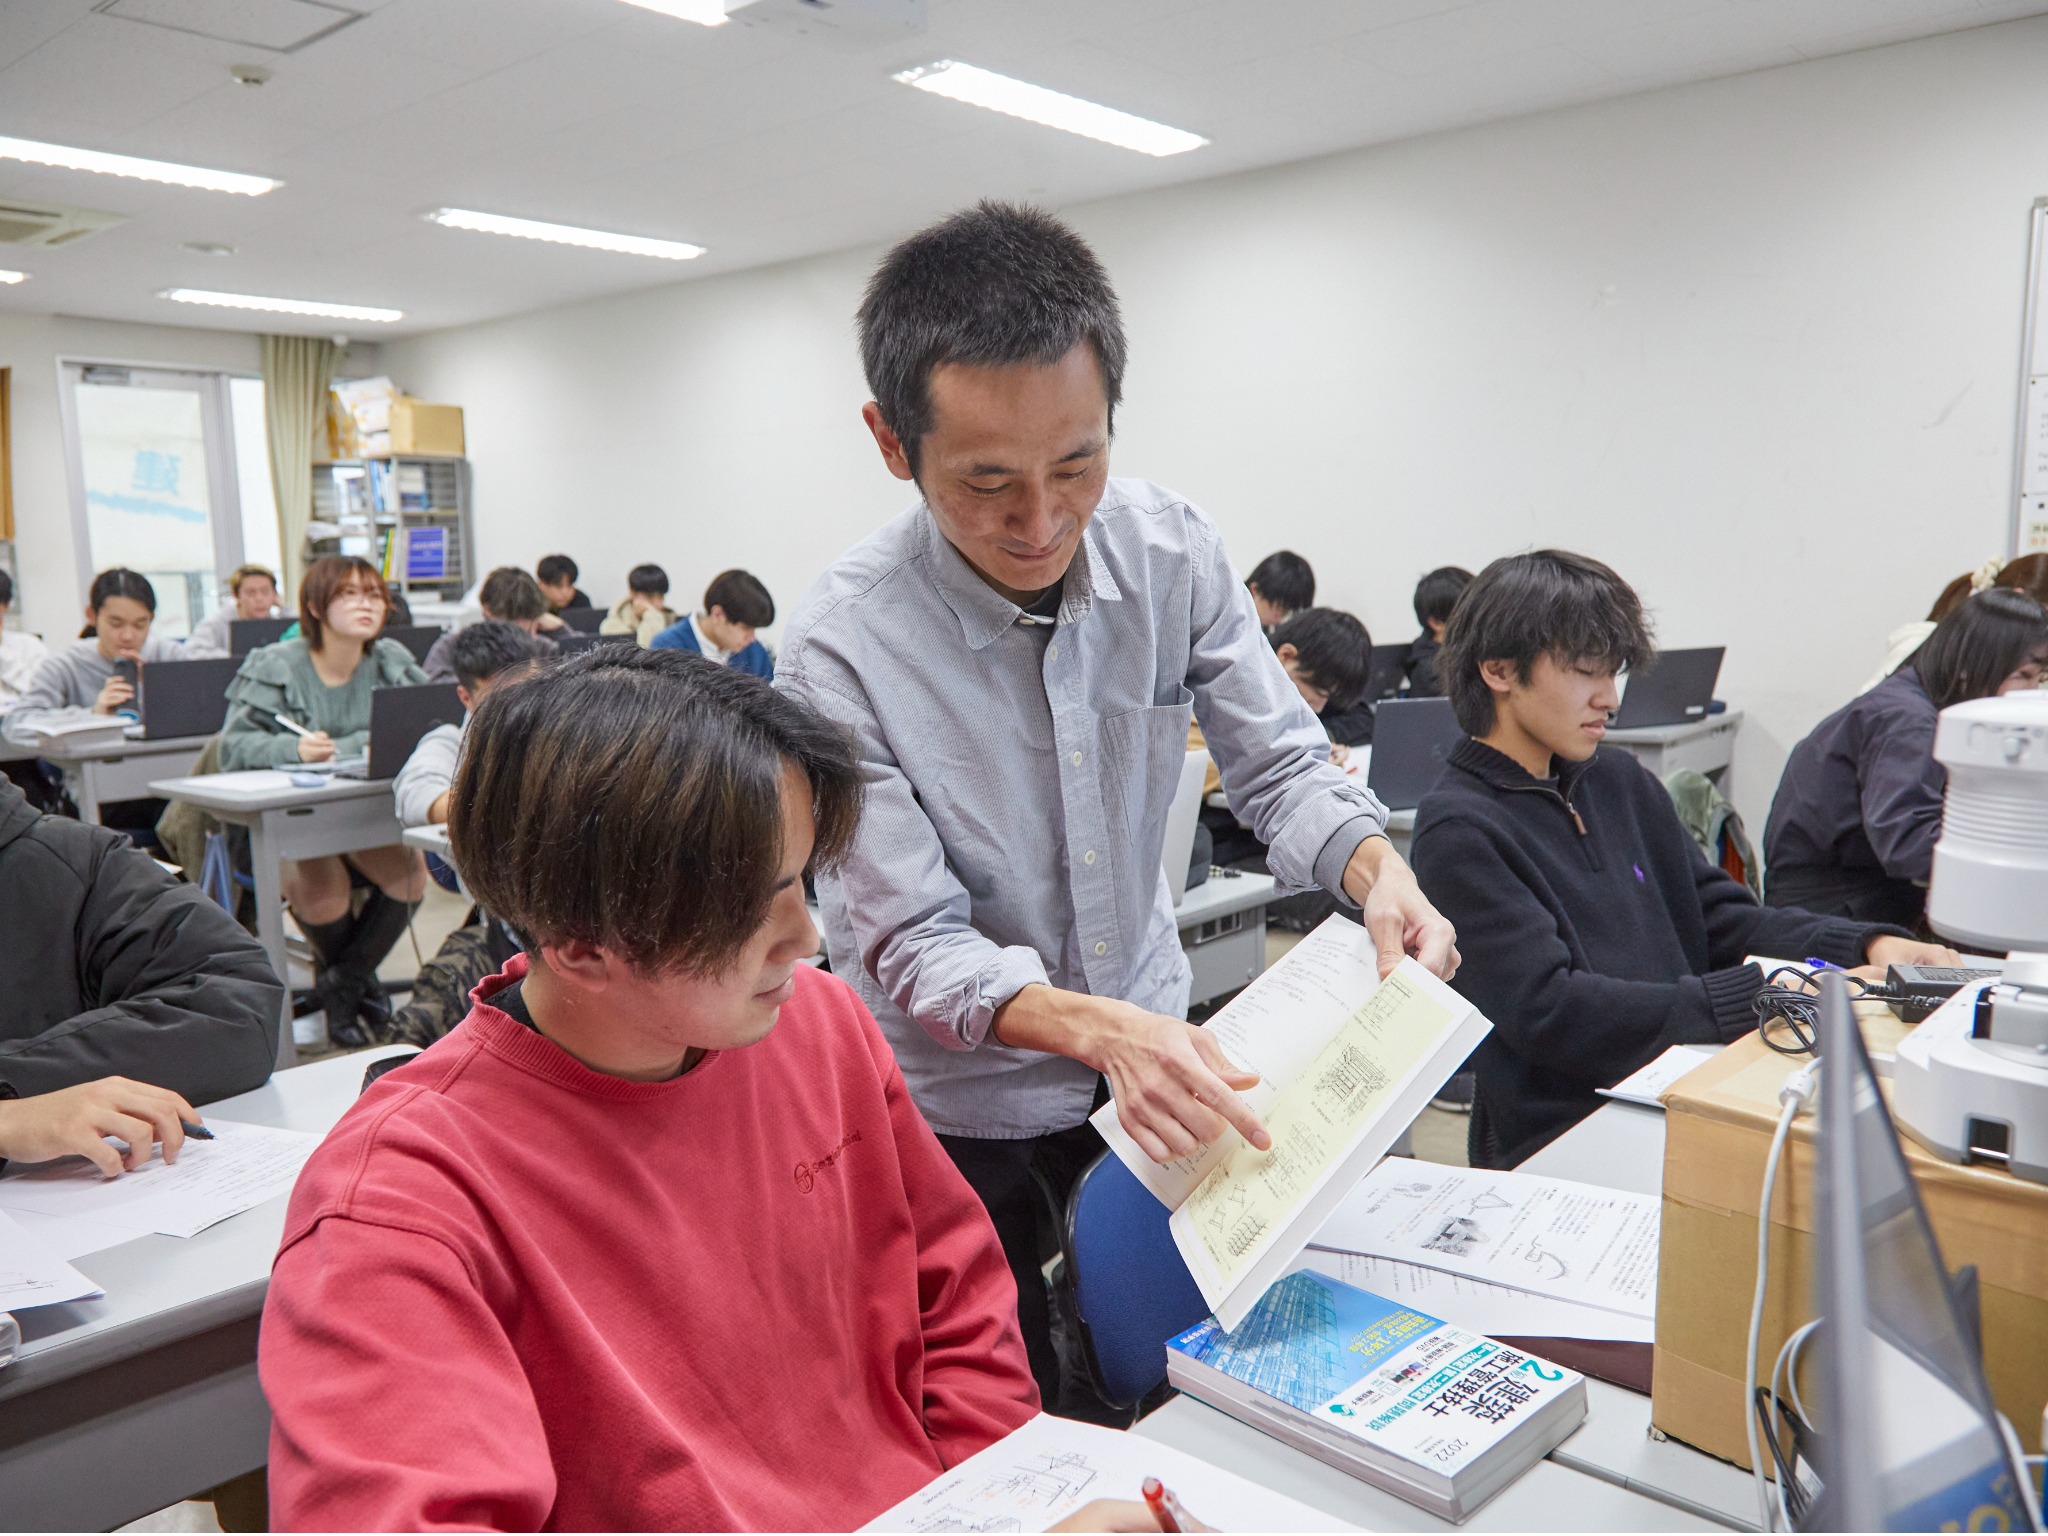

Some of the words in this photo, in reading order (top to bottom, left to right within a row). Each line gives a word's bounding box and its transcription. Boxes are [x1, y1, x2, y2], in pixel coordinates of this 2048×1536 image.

[1422, 1350, 1525, 1417] 施工管理技士
[1365, 1398, 1417, 1431] 問題解説
[1434, 1439, 1468, 1461] 2022
